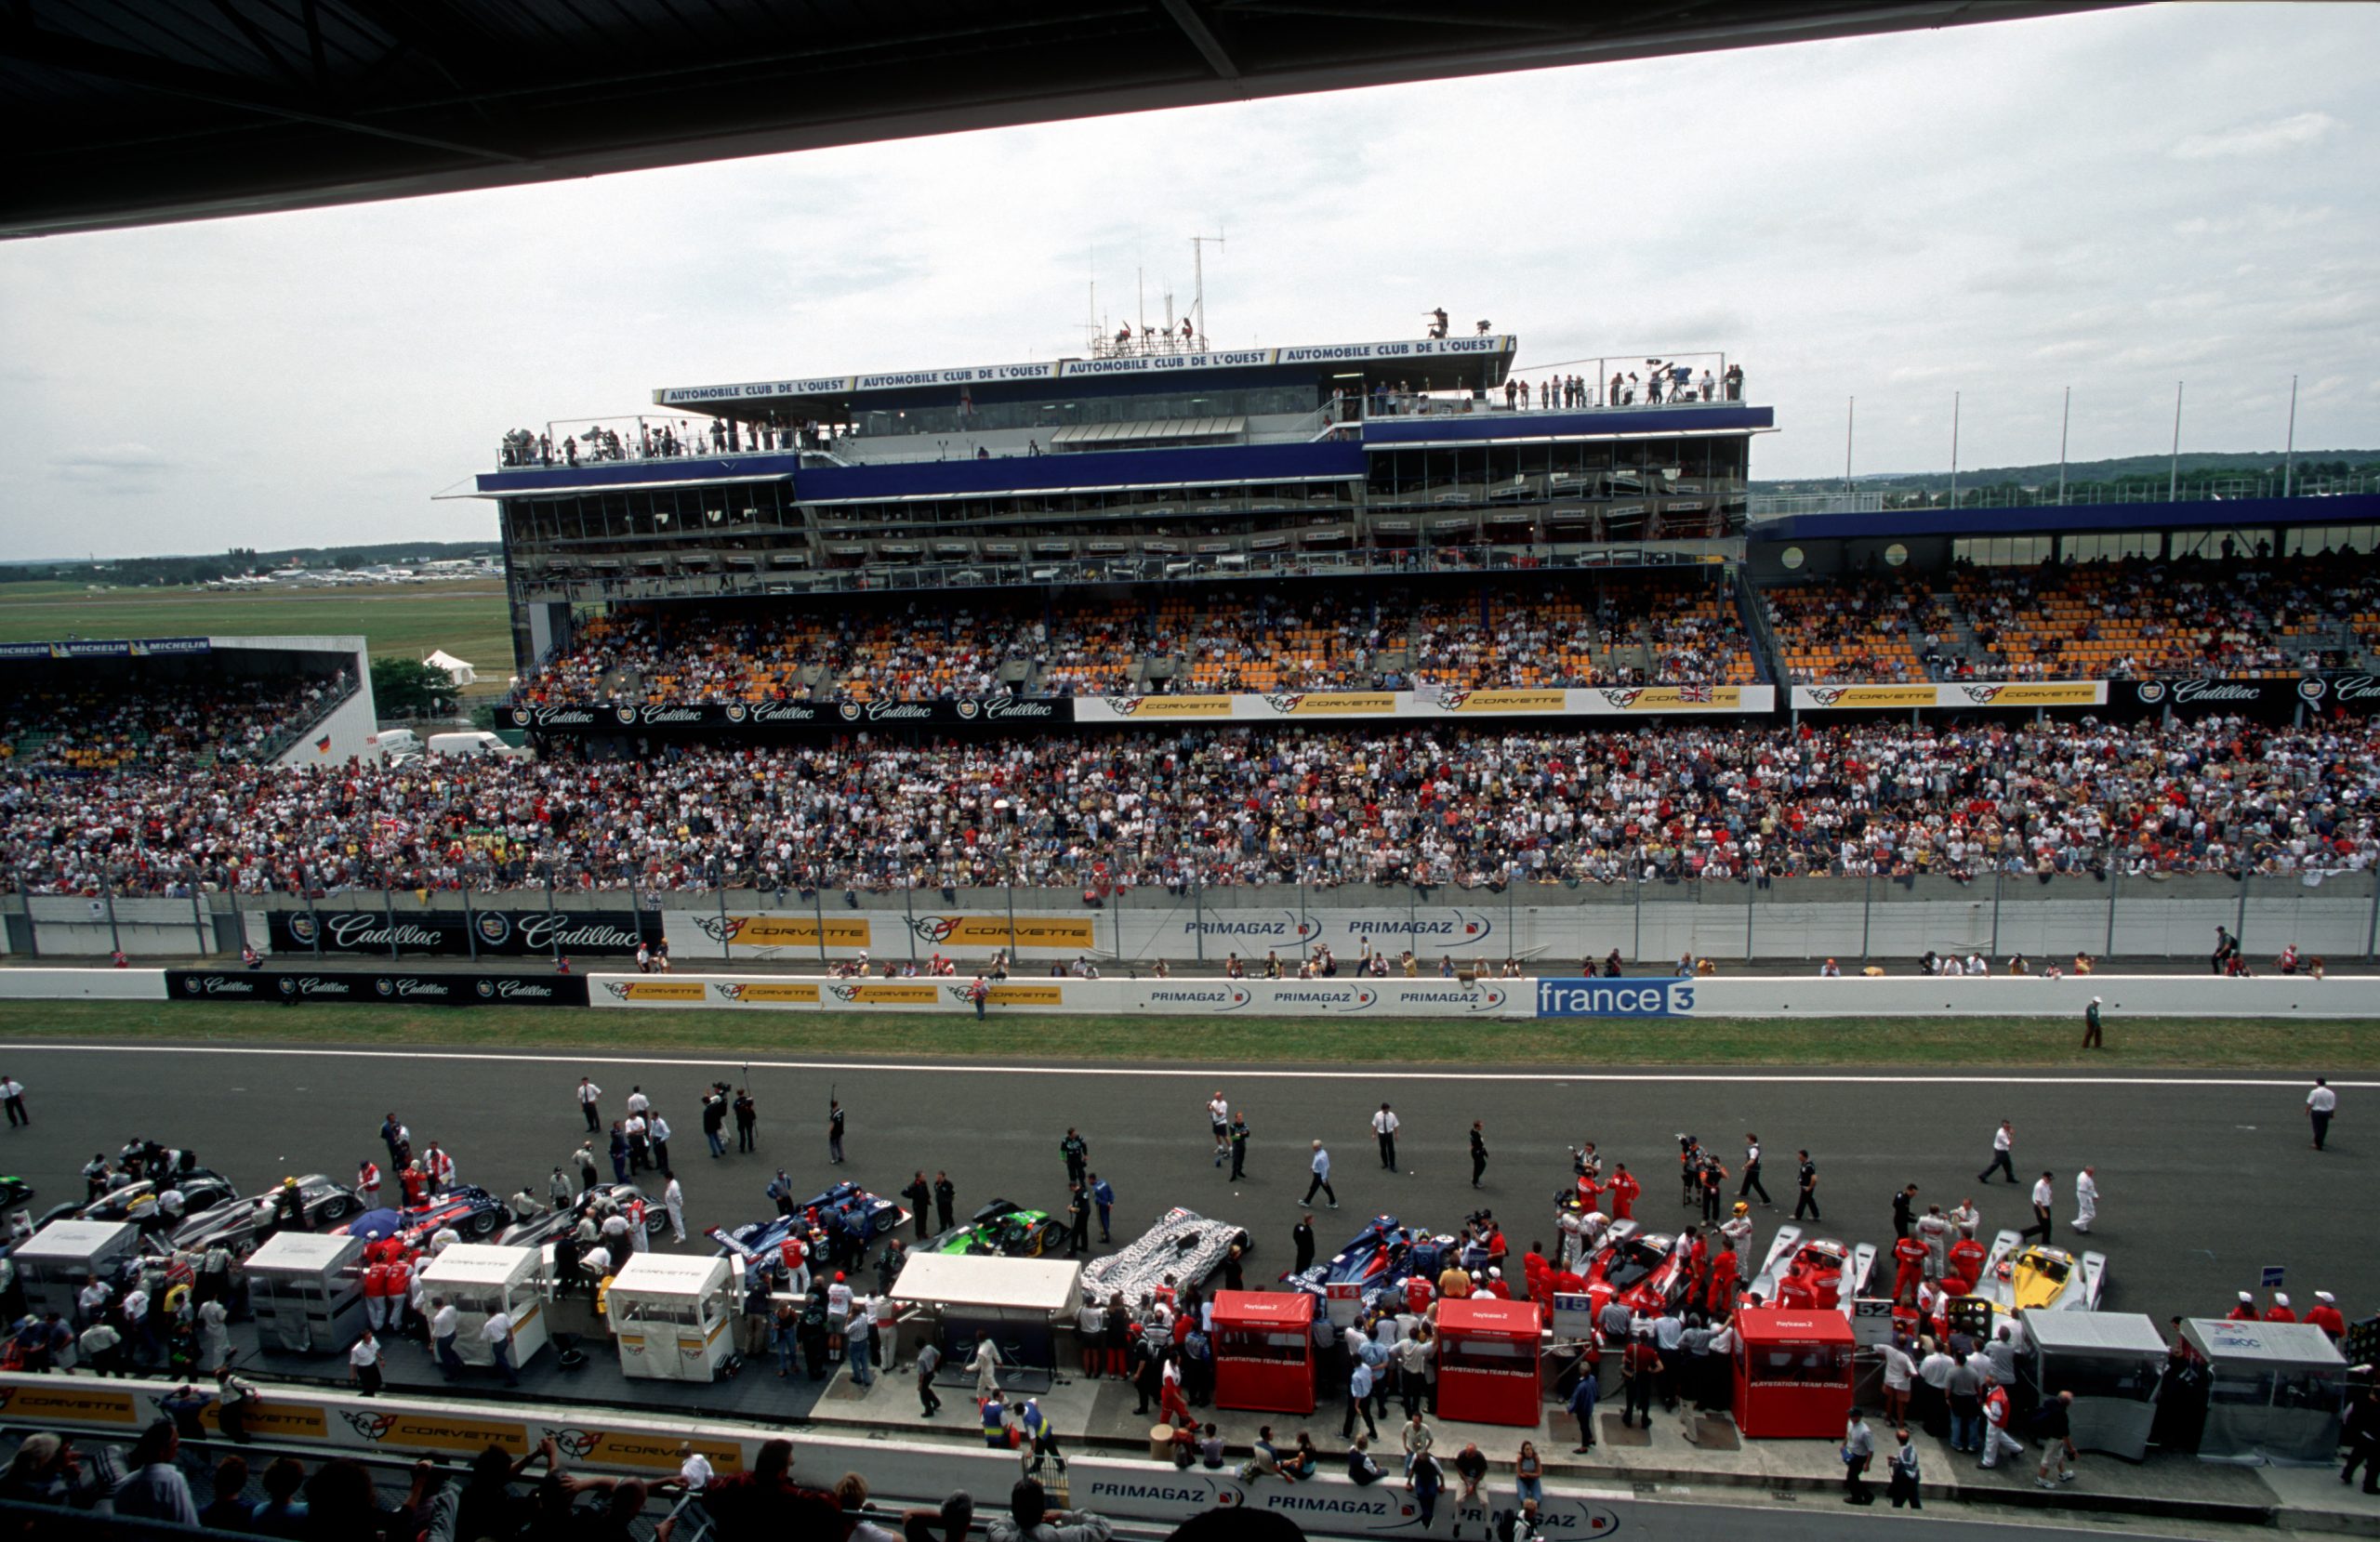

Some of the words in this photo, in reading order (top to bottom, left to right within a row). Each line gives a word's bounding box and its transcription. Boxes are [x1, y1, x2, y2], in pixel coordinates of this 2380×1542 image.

[1287, 347, 1370, 361] AUTOMOBILE
[1378, 344, 1408, 355] CLUB
[1416, 342, 1433, 353] DE
[1440, 339, 1495, 351] L'OUEST
[1069, 359, 1148, 374] AUTOMOBILE
[1155, 357, 1184, 368] CLUB
[1192, 356, 1207, 366] DE
[1214, 352, 1265, 364] L'OUEST
[863, 373, 938, 387] AUTOMOBILE
[944, 370, 972, 381] CLUB
[979, 368, 993, 379] DE
[999, 365, 1049, 377] L'OUEST
[669, 385, 740, 400] AUTOMOBILE
[746, 384, 773, 395] CLUB
[778, 383, 792, 392] DE
[798, 380, 844, 392] L'OUEST
[0, 646, 48, 654] ICHELIN
[70, 643, 128, 652] MICHELIN
[149, 641, 208, 651] MICHELIN
[1848, 692, 1936, 701] CORVETTE
[2173, 679, 2260, 703] Cadillac
[866, 699, 932, 721] Cadillac
[984, 697, 1051, 719] Cadillac
[1306, 699, 1394, 707] CORVETTE
[536, 706, 593, 727] Cadillac
[641, 705, 701, 725] Cadillac
[750, 701, 814, 723] Cadillac
[328, 915, 442, 946] Cadillac
[519, 915, 641, 948] Cadillac
[749, 926, 865, 937] CORVETTE
[965, 926, 1088, 937] CORVETTE
[1185, 922, 1285, 934] PRIMAGAZ
[1348, 921, 1453, 934] PRIMAGAZ
[204, 976, 253, 993] Cadillac
[298, 978, 350, 995] Cadillac
[396, 978, 448, 995] Cadillac
[497, 980, 552, 997] Cadillac
[1151, 993, 1225, 1002] PRIMAGAZ
[1275, 993, 1351, 1002] PRIMAGAZ
[1400, 993, 1479, 1002] PRIMAGAZ
[1540, 982, 1661, 1012] france
[1674, 987, 1695, 1010] 3
[1329, 1286, 1357, 1298] 14
[1560, 1297, 1588, 1310] 15
[1859, 1303, 1890, 1316] 52
[20, 1397, 129, 1411] CORVETTE
[207, 1409, 321, 1426] CVETTE
[402, 1425, 522, 1443] CORVETTE
[1091, 1483, 1205, 1502] PRIMAGAZ
[1268, 1496, 1386, 1515] PRIMAGAZ
